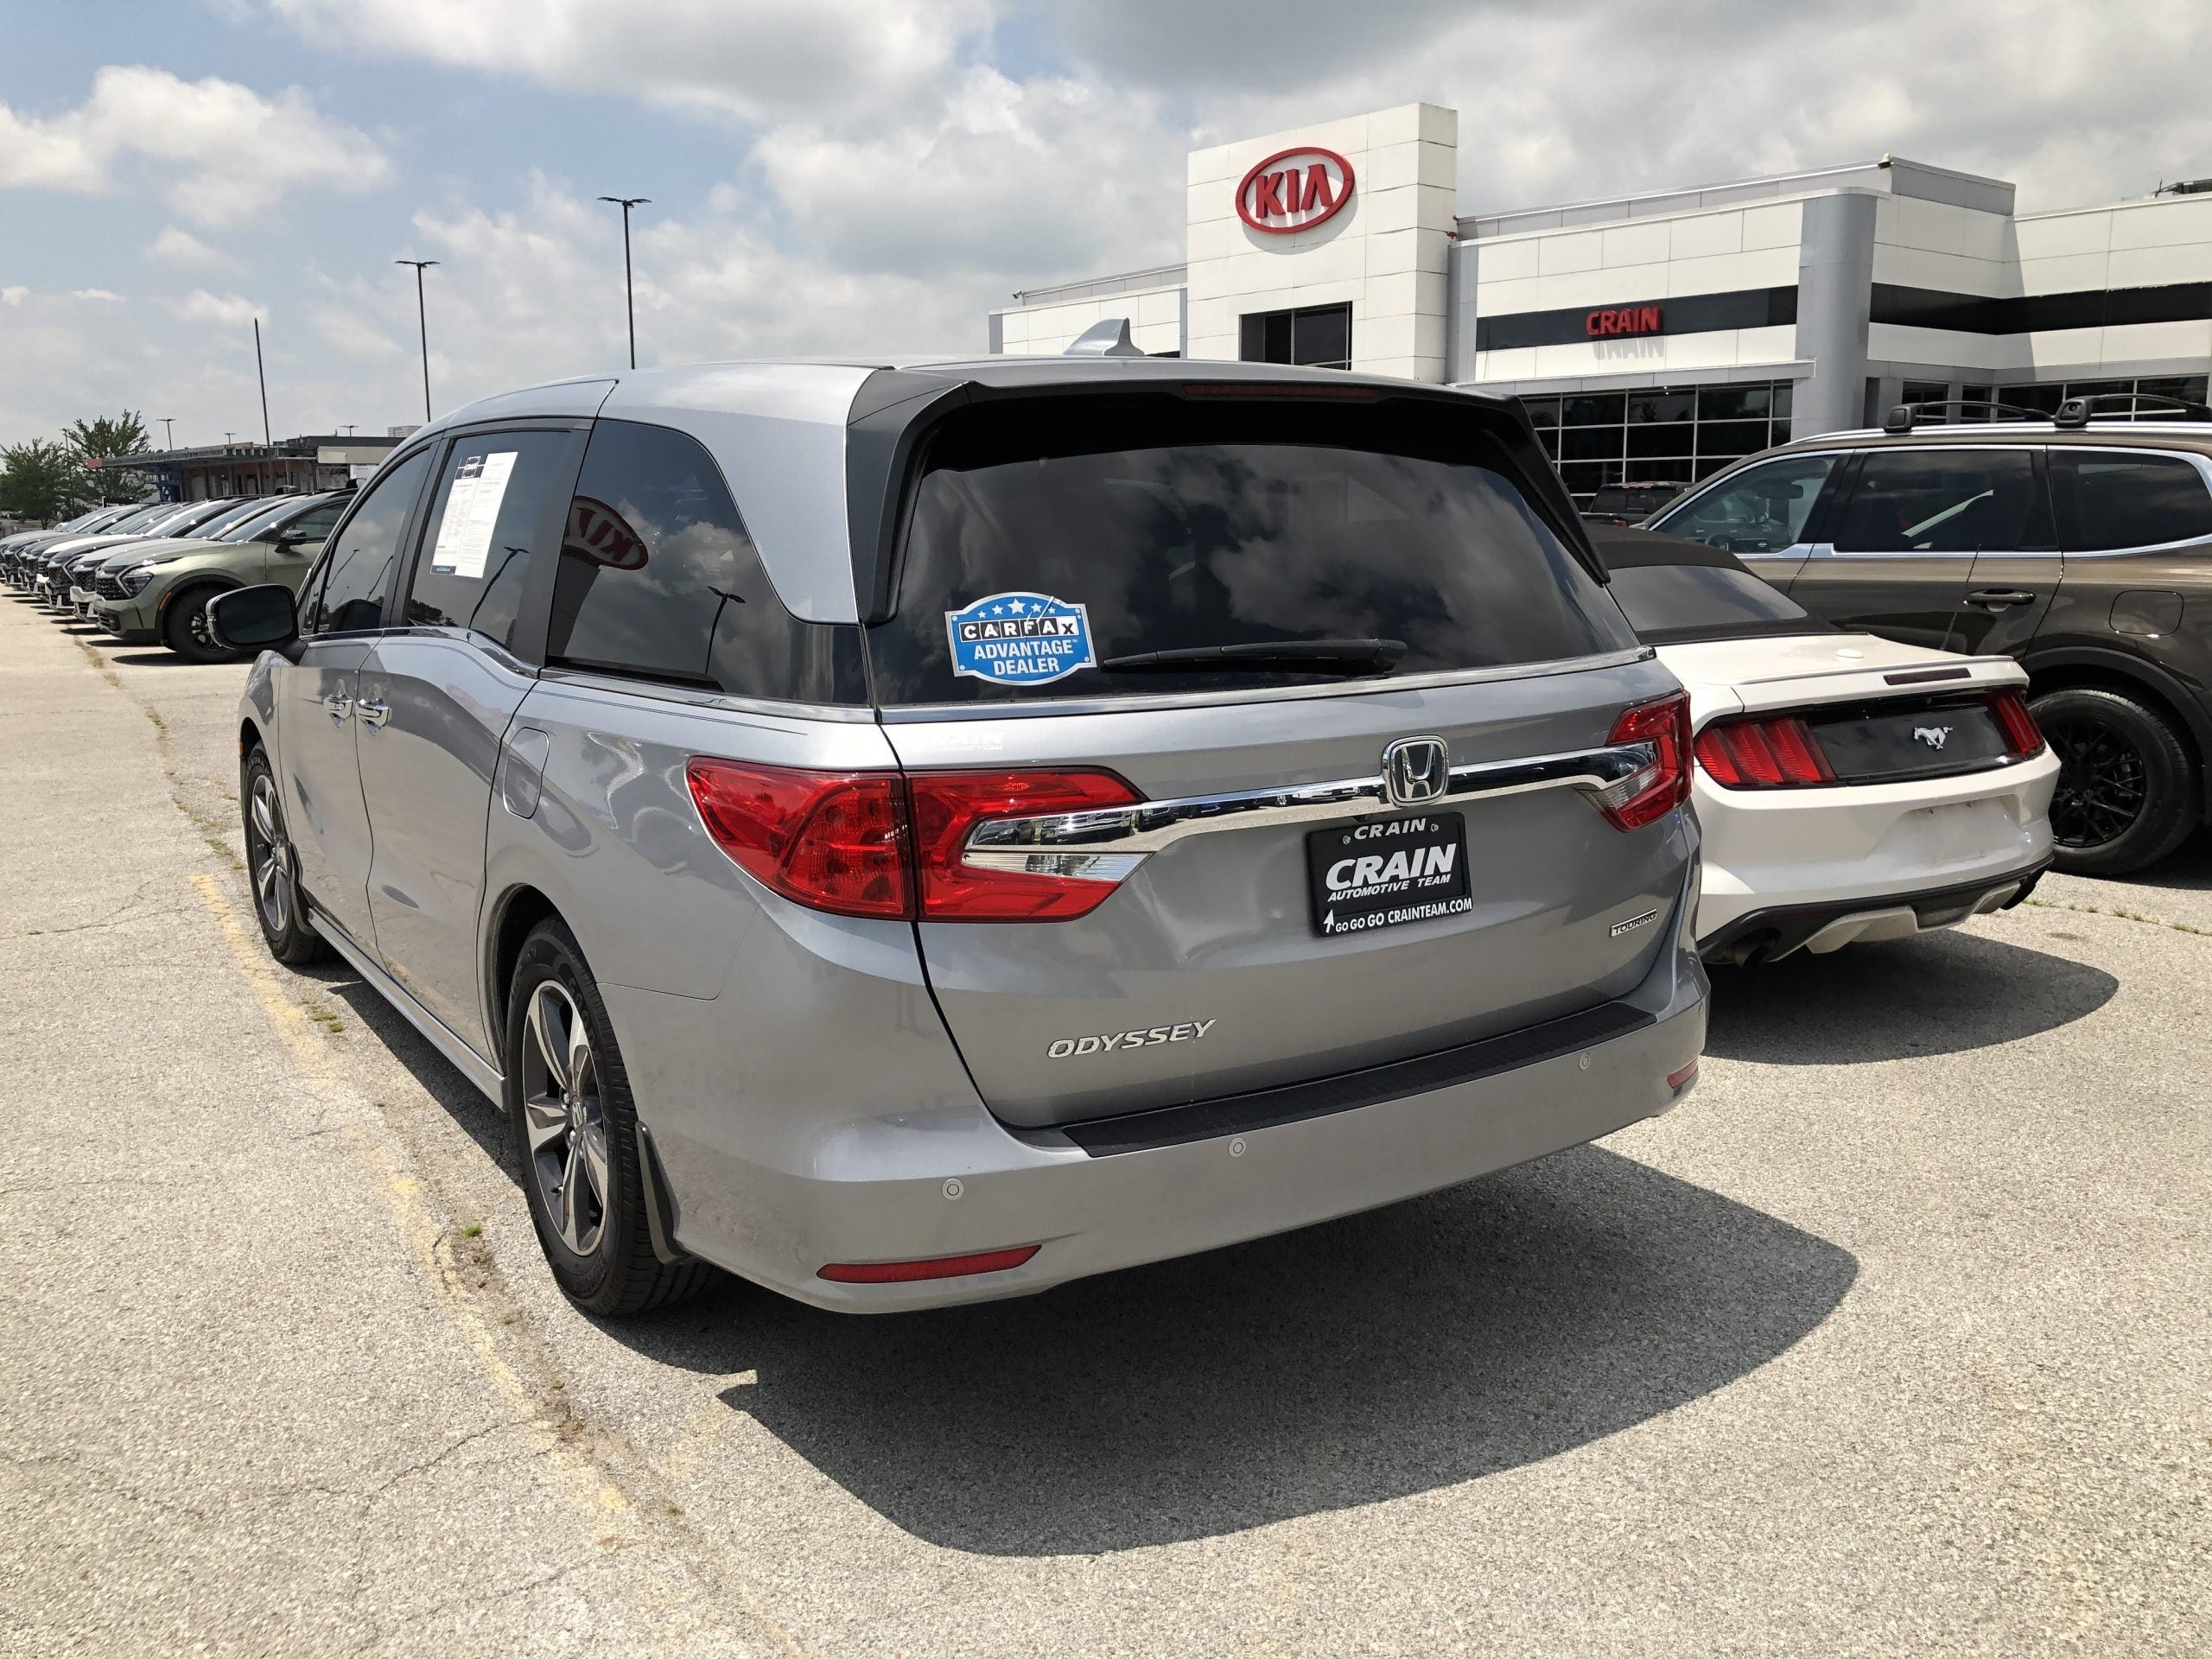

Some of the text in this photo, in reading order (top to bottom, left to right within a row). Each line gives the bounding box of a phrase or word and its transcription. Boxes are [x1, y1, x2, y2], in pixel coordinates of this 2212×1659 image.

[1255, 163, 1333, 219] KIA
[1586, 305, 1661, 335] CRAIN
[963, 619, 1075, 639] CARFAX
[994, 657, 1060, 676] DEALER
[1354, 818, 1427, 840] CRAIN
[1325, 843, 1457, 891] CRAIN
[1327, 874, 1451, 902] AUTOMOTIVE TEAM
[1335, 898, 1472, 932] GO GO GO CRAINTEAM.COM
[1612, 910, 1657, 934] TOURING
[1047, 1019, 1217, 1058] ODYSSEY
